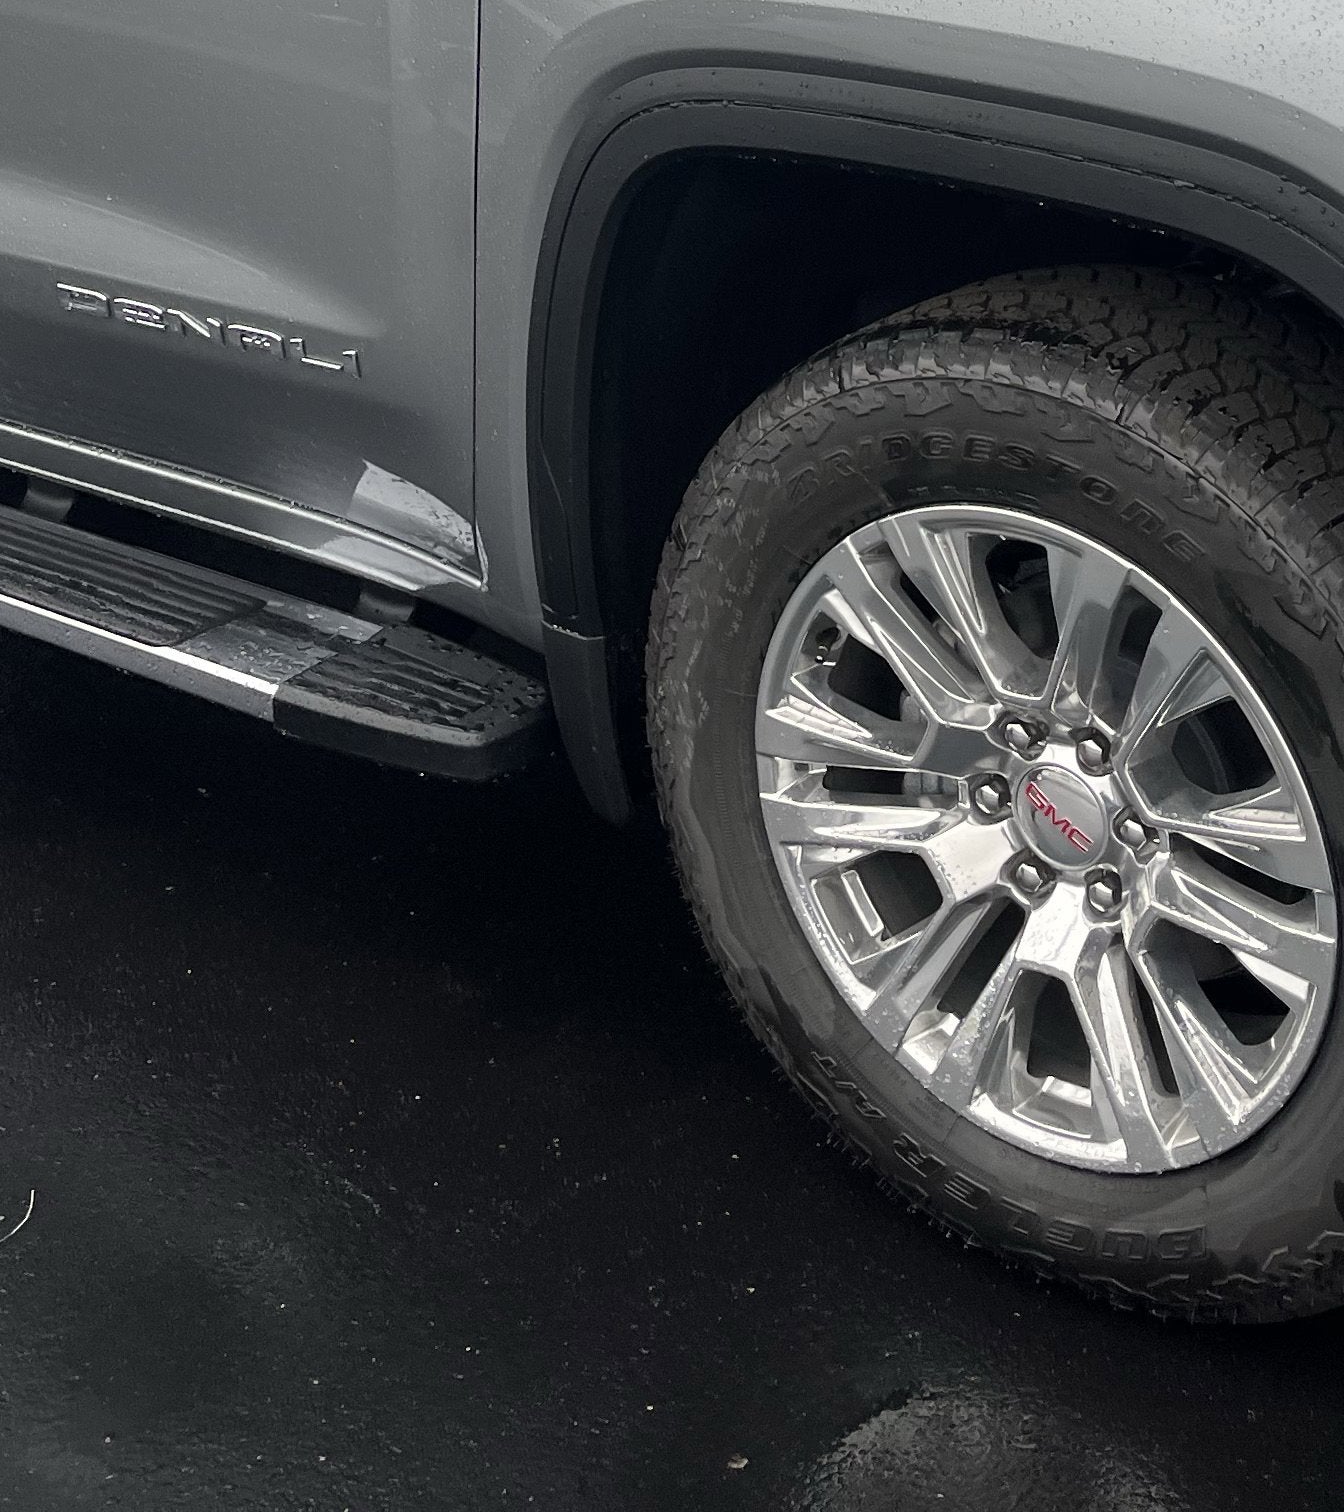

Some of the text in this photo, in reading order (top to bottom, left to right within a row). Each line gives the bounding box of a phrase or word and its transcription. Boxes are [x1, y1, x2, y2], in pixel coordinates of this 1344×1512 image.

[56, 280, 363, 380] DENALI
[784, 427, 1209, 565] BRIDGESTONE
[1025, 780, 1096, 855] GMC
